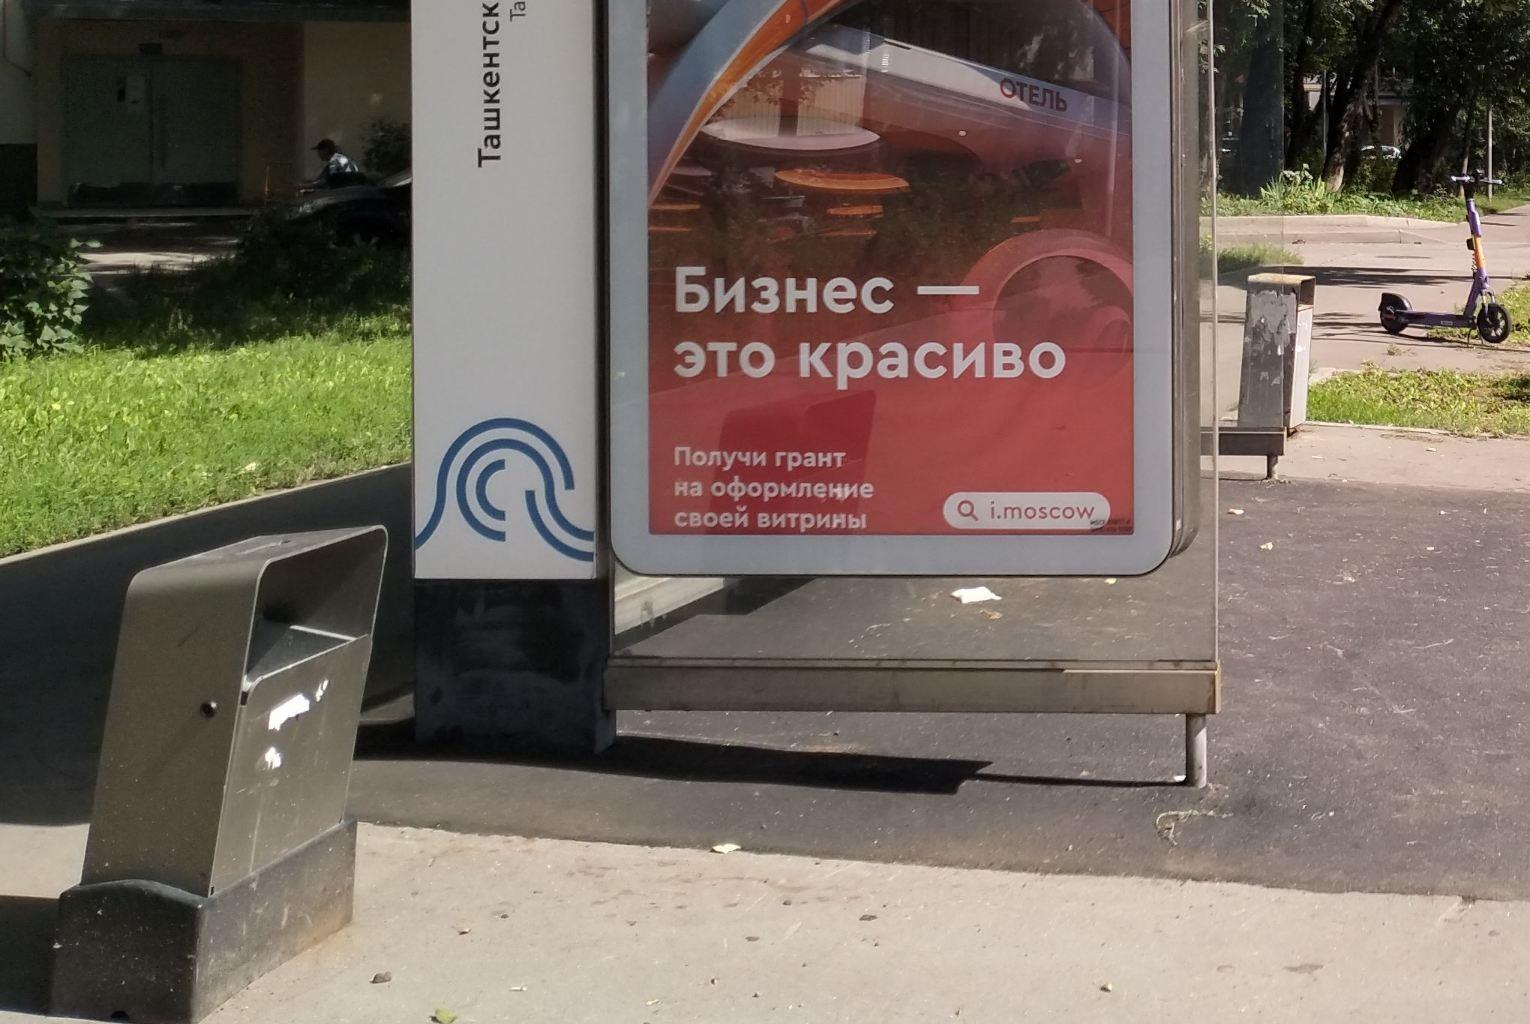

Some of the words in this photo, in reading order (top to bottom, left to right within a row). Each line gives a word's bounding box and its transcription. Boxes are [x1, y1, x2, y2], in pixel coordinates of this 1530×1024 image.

[1000, 78, 1067, 113] ОТЕЛЬ
[675, 266, 895, 314] Бизнес
[674, 340, 776, 379] это
[800, 340, 1067, 390] красиво
[674, 446, 768, 471] Получи
[774, 451, 846, 471] грант
[674, 480, 703, 497] на
[710, 475, 874, 502] оформление
[674, 505, 749, 528] своей
[757, 512, 867, 532] витрины
[991, 501, 1096, 520] i.moscow
